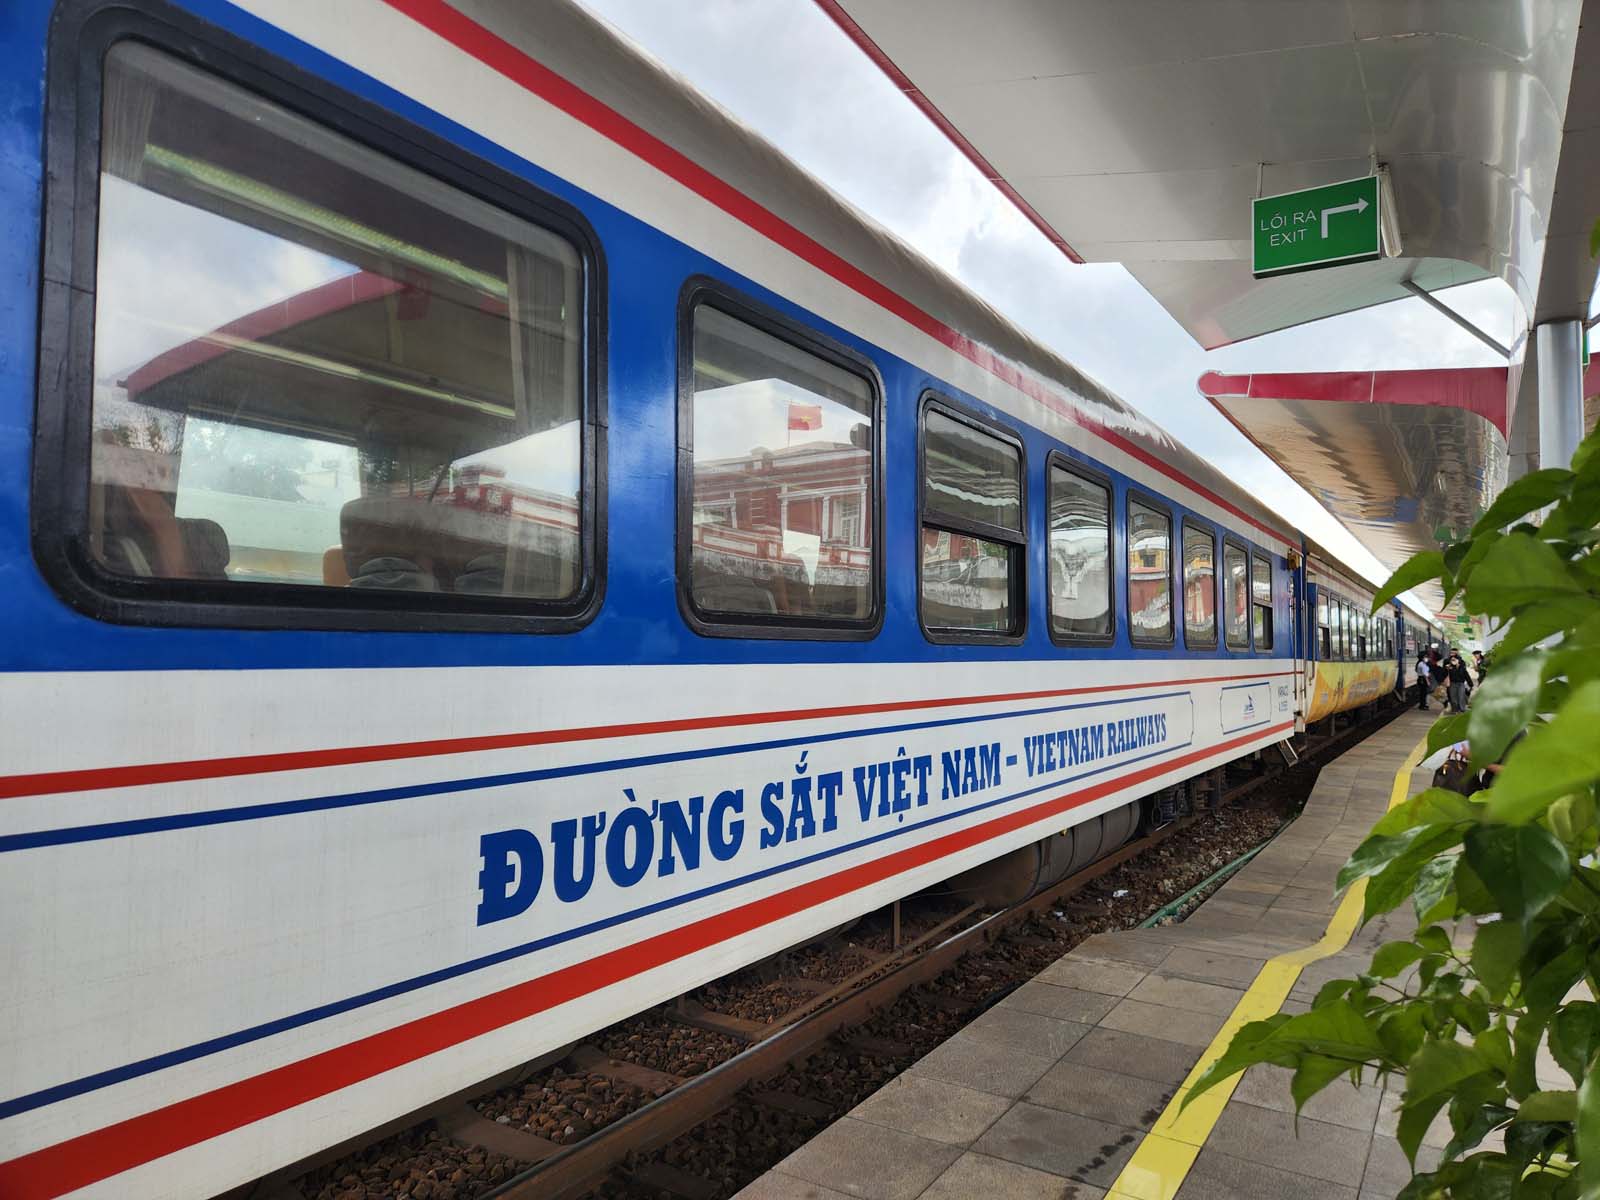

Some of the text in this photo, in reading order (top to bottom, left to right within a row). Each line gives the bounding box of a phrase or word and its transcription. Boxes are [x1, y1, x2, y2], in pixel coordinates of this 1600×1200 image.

[1293, 209, 1317, 225] RA
[1270, 228, 1308, 246] EXIT
[476, 788, 745, 927] ĐƯỜNG
[759, 750, 843, 850] SẮT
[853, 745, 932, 823] VIỆT
[941, 742, 1001, 801] NAM
[1023, 724, 1104, 778] VIETNAM
[1107, 713, 1167, 756] RAILWAYS
